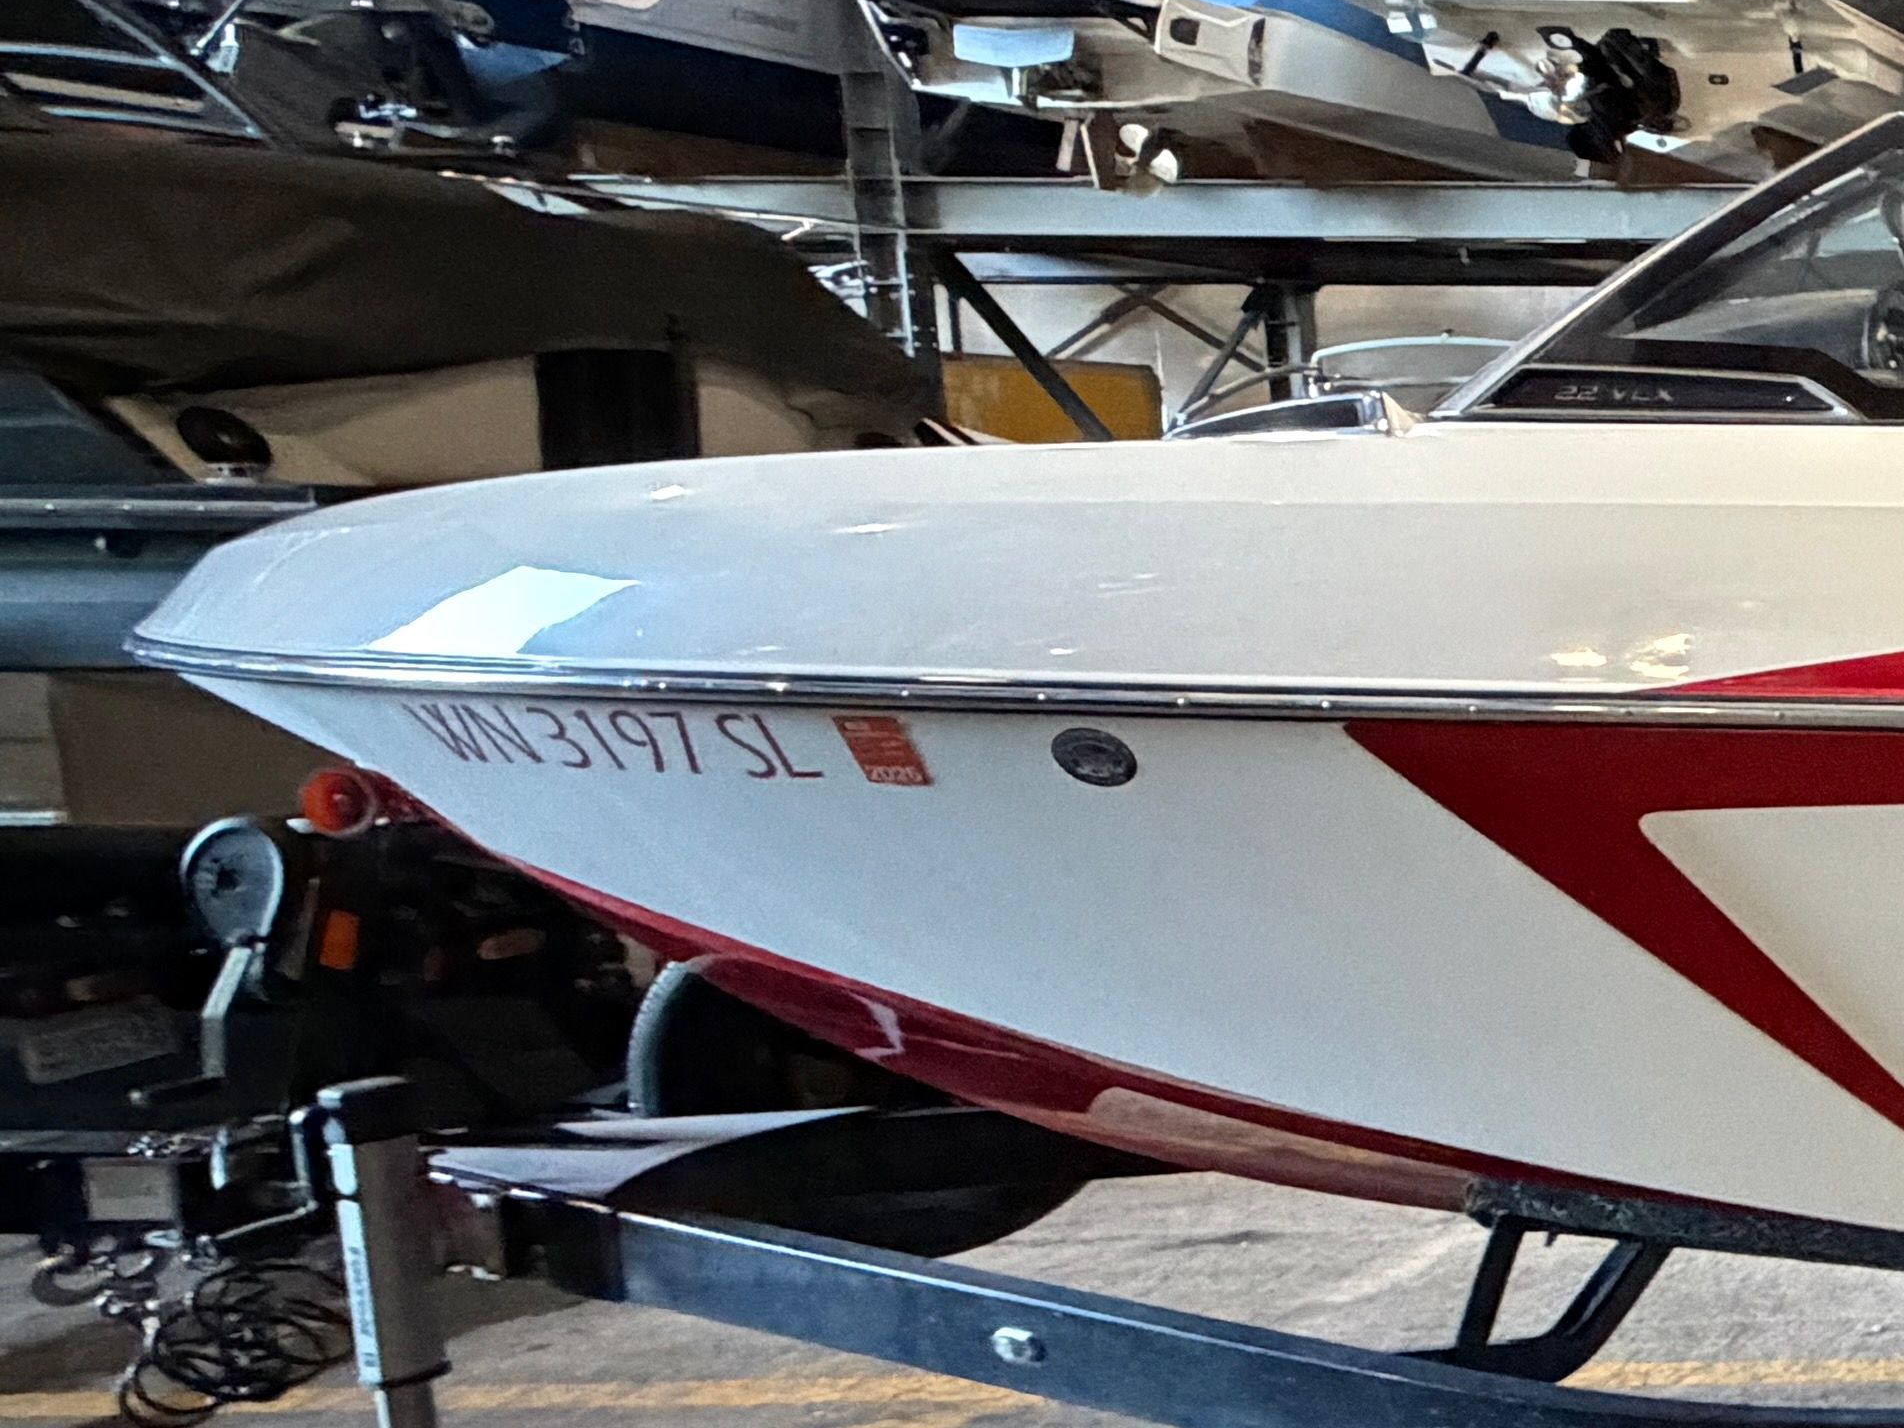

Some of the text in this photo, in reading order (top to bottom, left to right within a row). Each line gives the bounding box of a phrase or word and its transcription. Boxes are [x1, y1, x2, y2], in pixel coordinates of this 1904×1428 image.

[401, 703, 544, 764] WN
[526, 706, 702, 774] 3197
[714, 712, 825, 779] SL
